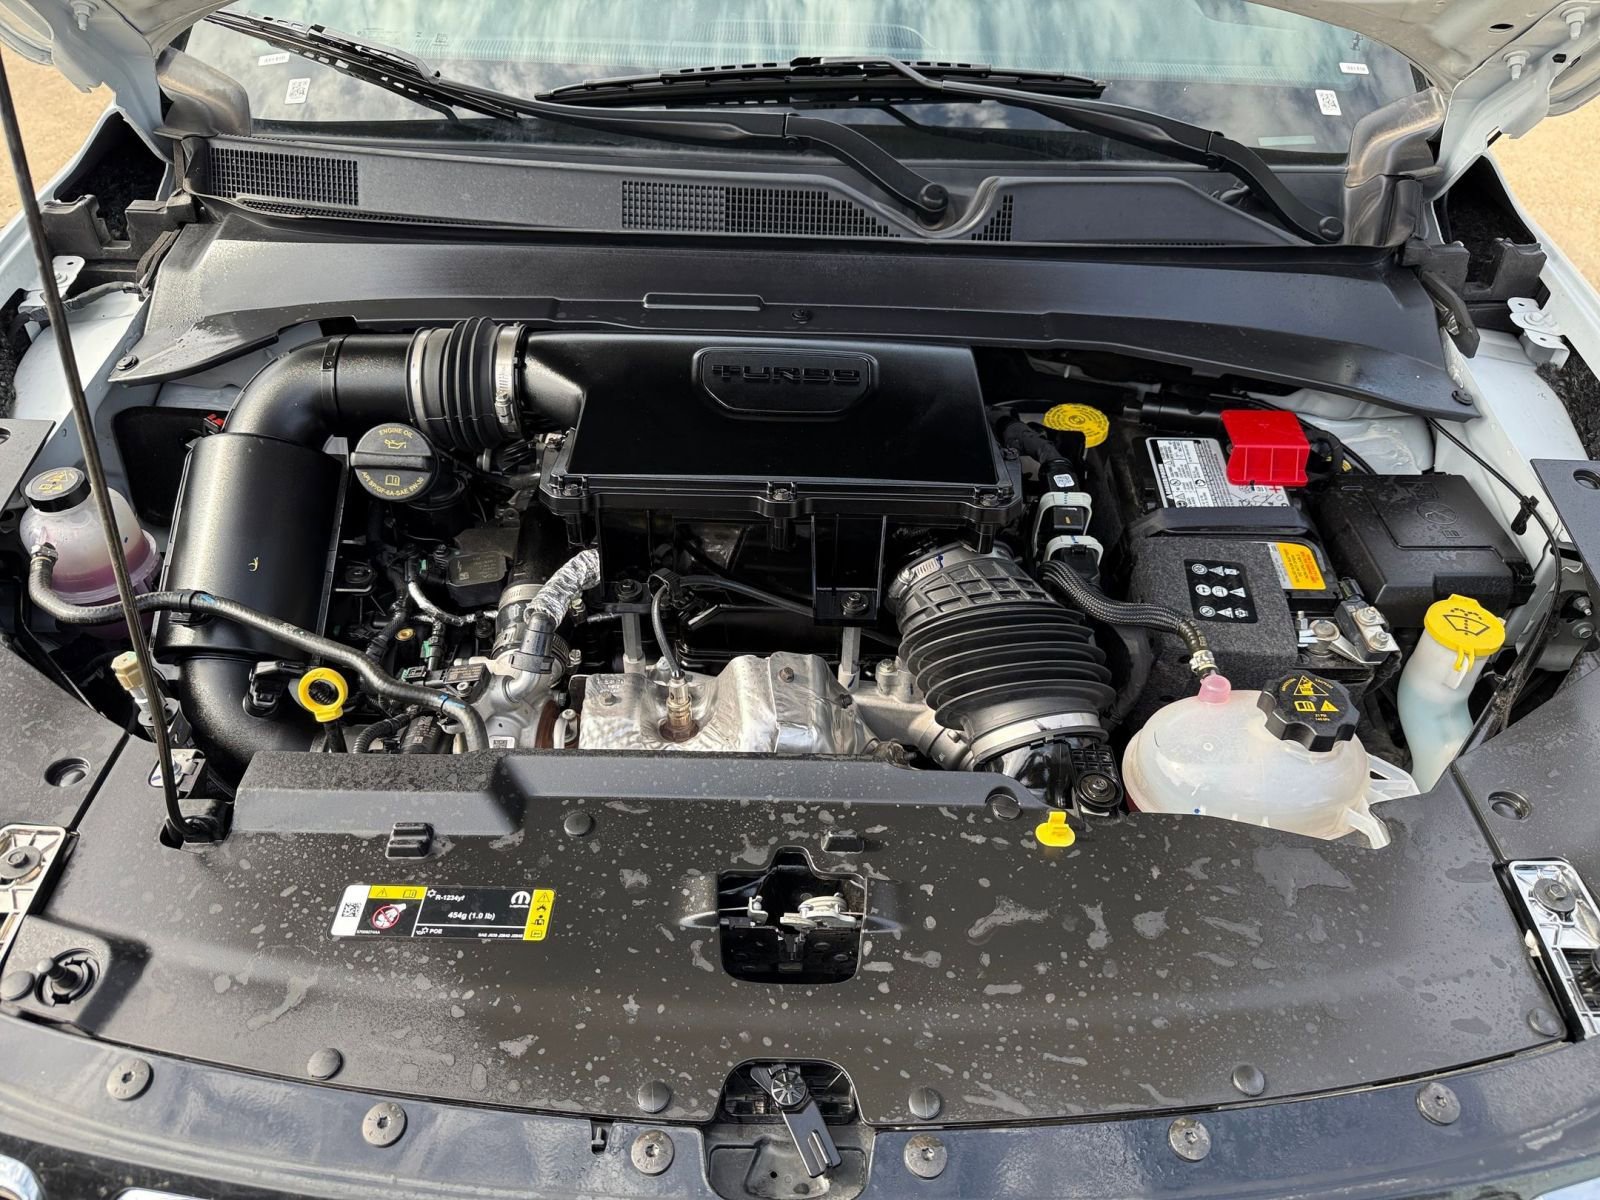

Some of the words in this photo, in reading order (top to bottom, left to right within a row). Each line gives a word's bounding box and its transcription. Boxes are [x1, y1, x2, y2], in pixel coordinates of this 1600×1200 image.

[379, 427, 403, 436] ENGINE
[403, 429, 413, 439] OIL
[435, 894, 466, 903] R-1234yf
[448, 912, 468, 921] 454g
[468, 912, 484, 921] (1.0
[484, 912, 496, 921] lb)
